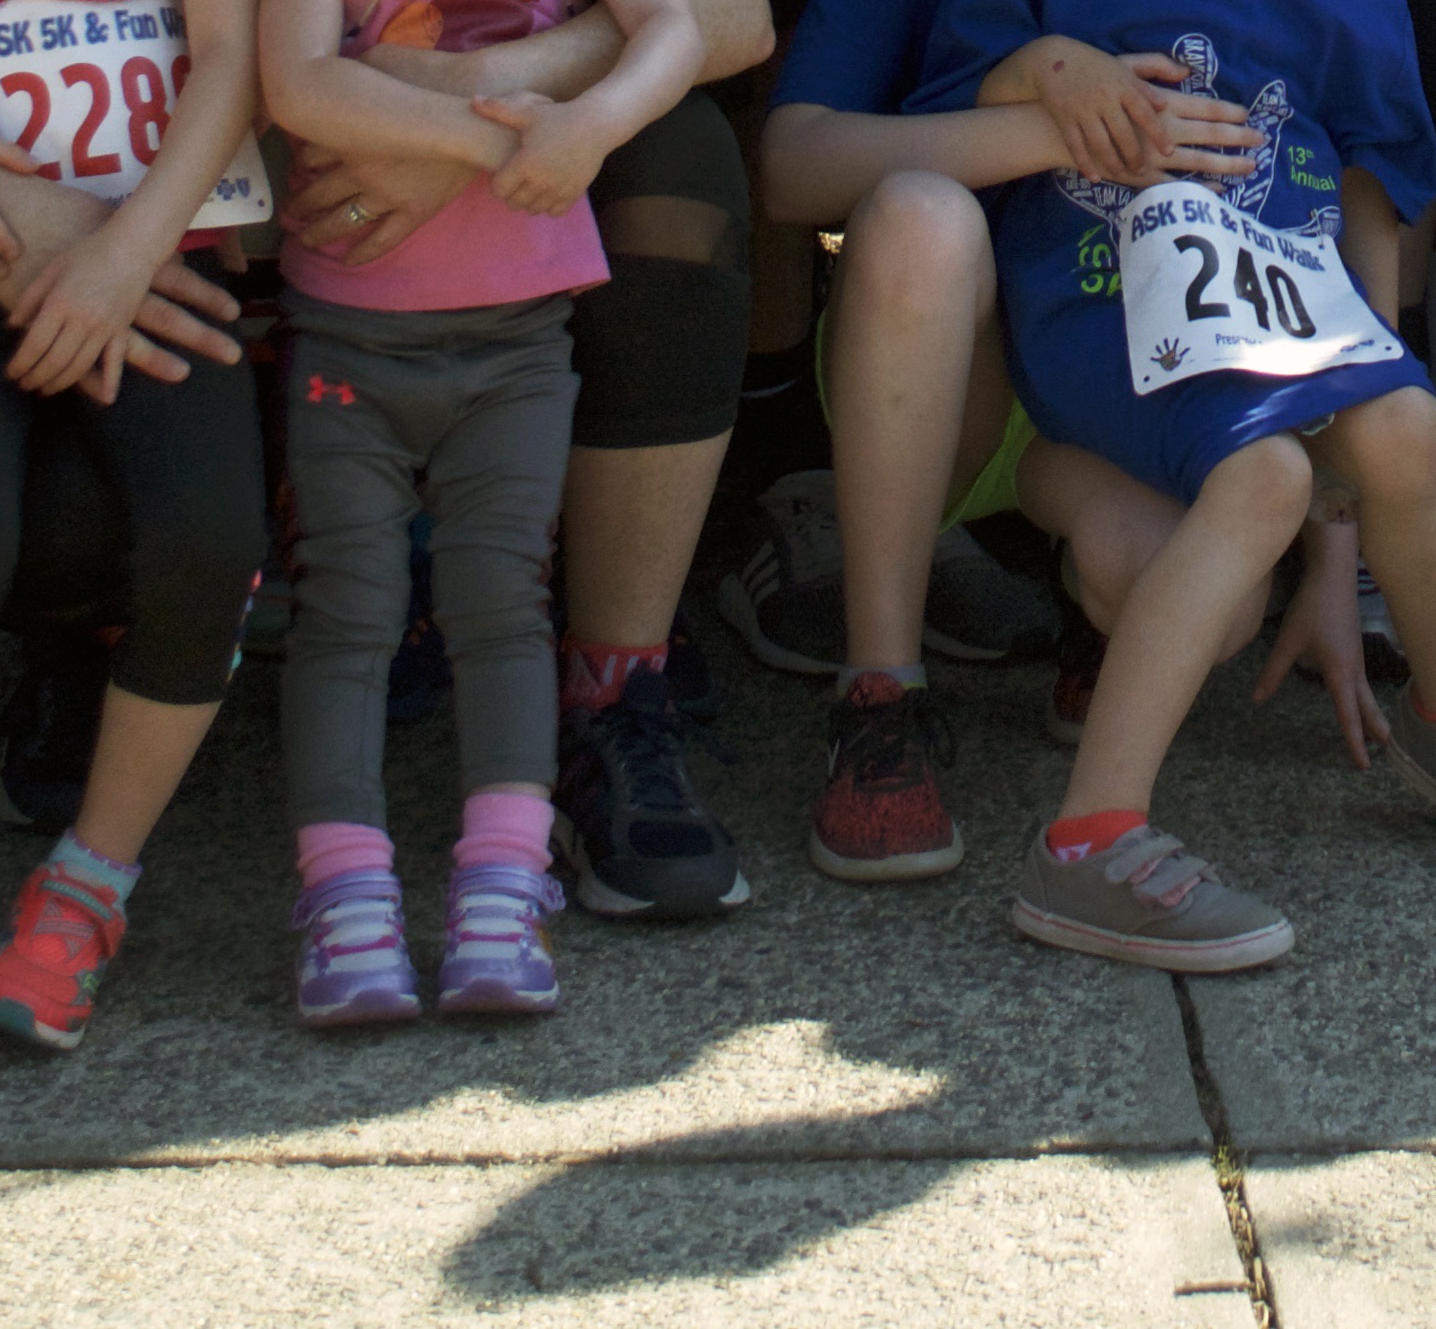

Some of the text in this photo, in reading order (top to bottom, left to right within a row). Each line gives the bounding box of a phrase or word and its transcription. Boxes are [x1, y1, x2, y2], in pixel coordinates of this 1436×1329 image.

[40, 13, 77, 48] 5K
[85, 11, 109, 43] &
[115, 9, 159, 41] Fun
[1289, 166, 1336, 191] Annual
[1130, 198, 1327, 272] ASK 5K Fun Walk
[1173, 233, 1317, 339] 240
